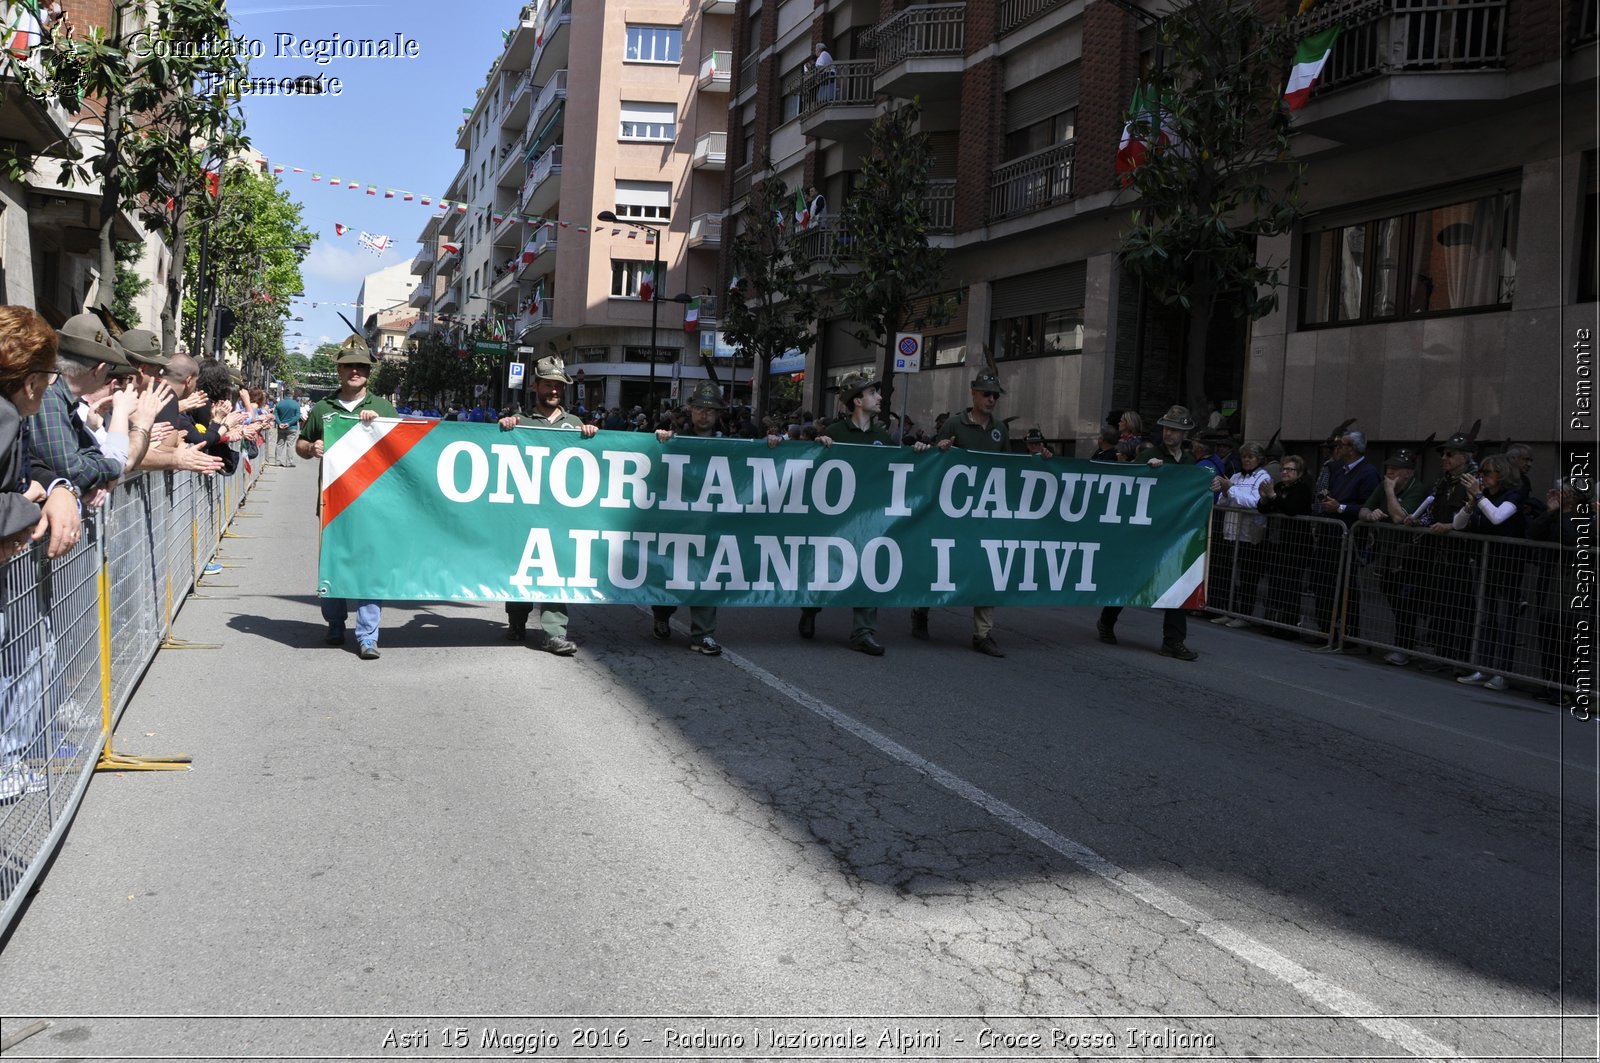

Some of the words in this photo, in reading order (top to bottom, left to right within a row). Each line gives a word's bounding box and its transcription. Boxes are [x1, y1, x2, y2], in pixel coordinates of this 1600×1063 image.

[513, 366, 521, 375] P
[436, 440, 857, 516] ONORIAMO
[884, 463, 914, 517] I
[938, 464, 1158, 526] CADUTI
[509, 527, 903, 593] AIUTANDO
[930, 538, 956, 592] I
[980, 539, 1101, 593] VIVI
